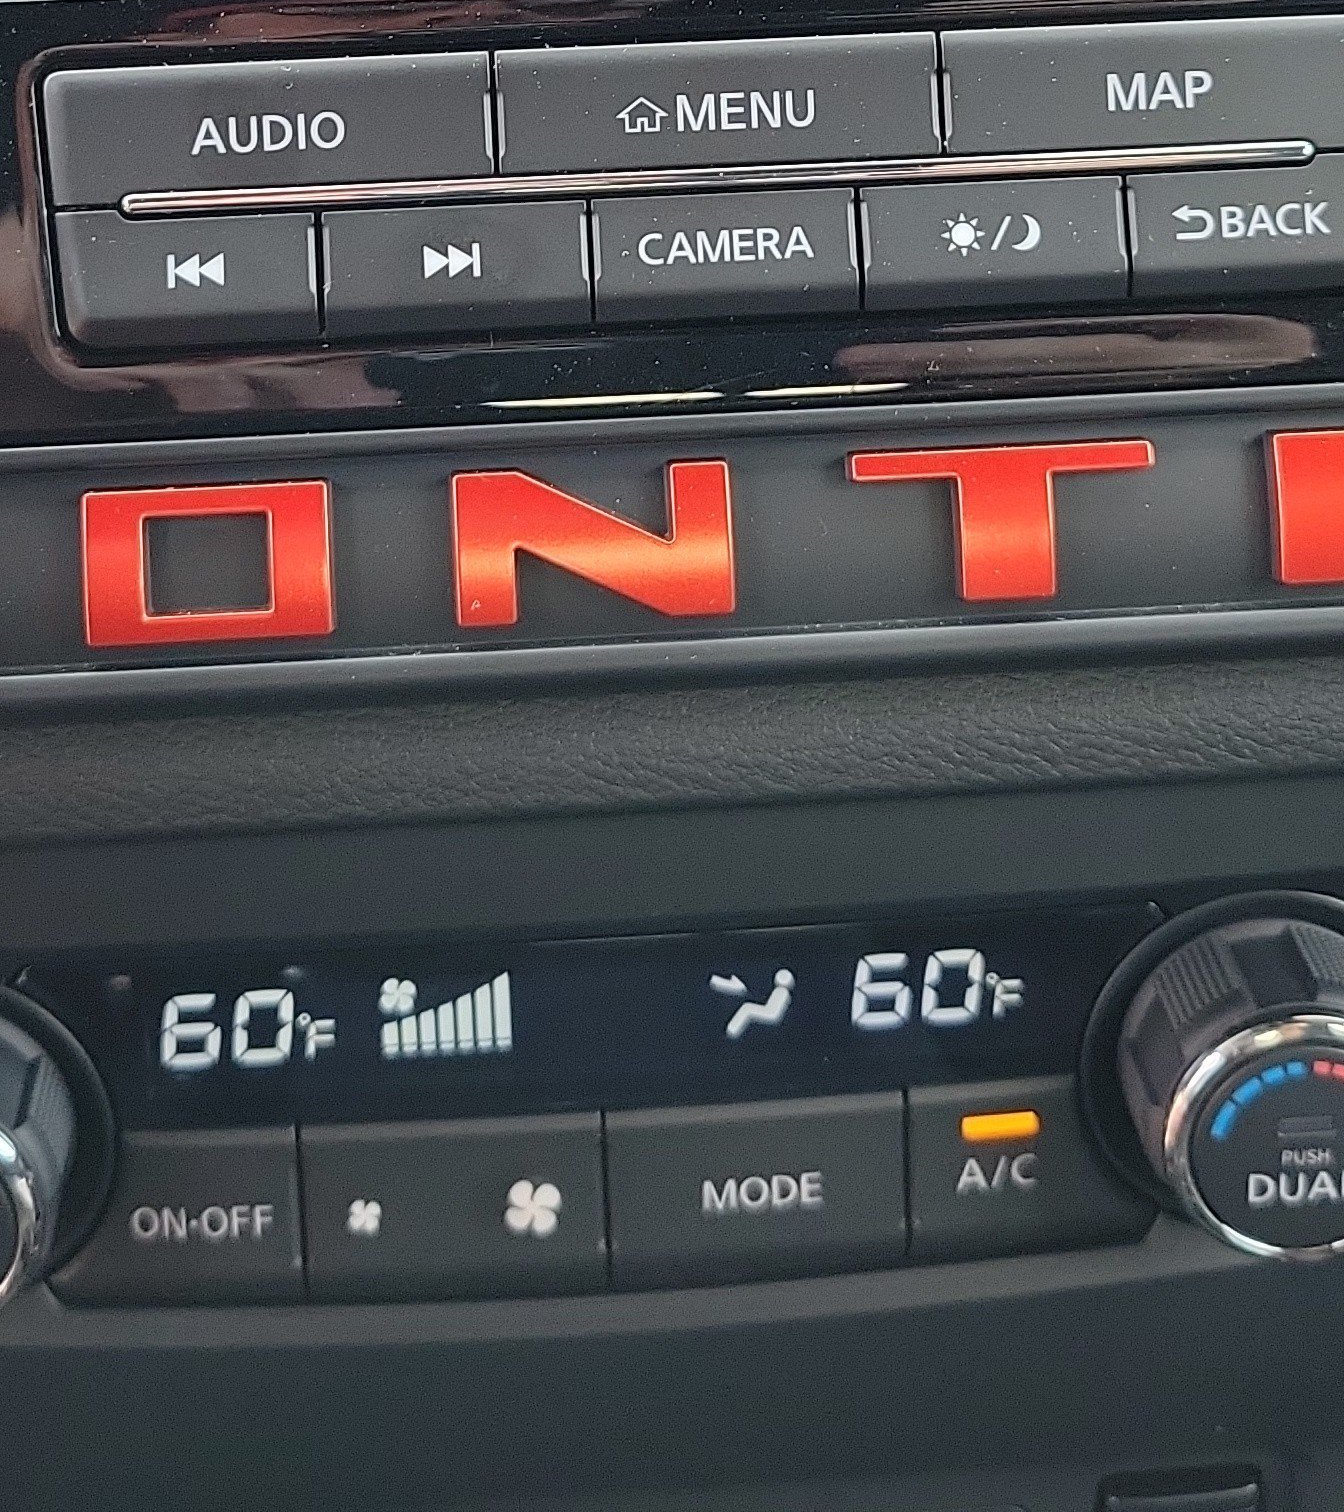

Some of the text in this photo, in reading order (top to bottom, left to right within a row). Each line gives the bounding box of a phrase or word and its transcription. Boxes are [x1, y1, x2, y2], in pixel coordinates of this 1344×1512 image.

[675, 90, 816, 133] MENU
[1105, 70, 1214, 112] MAP
[191, 110, 346, 155] AUDIO
[1219, 202, 1332, 240] BACK
[636, 225, 814, 267] CAMERA
[956, 1153, 1039, 1195] A/C
[1280, 1149, 1331, 1167] PUSH
[701, 1170, 824, 1214] MODE
